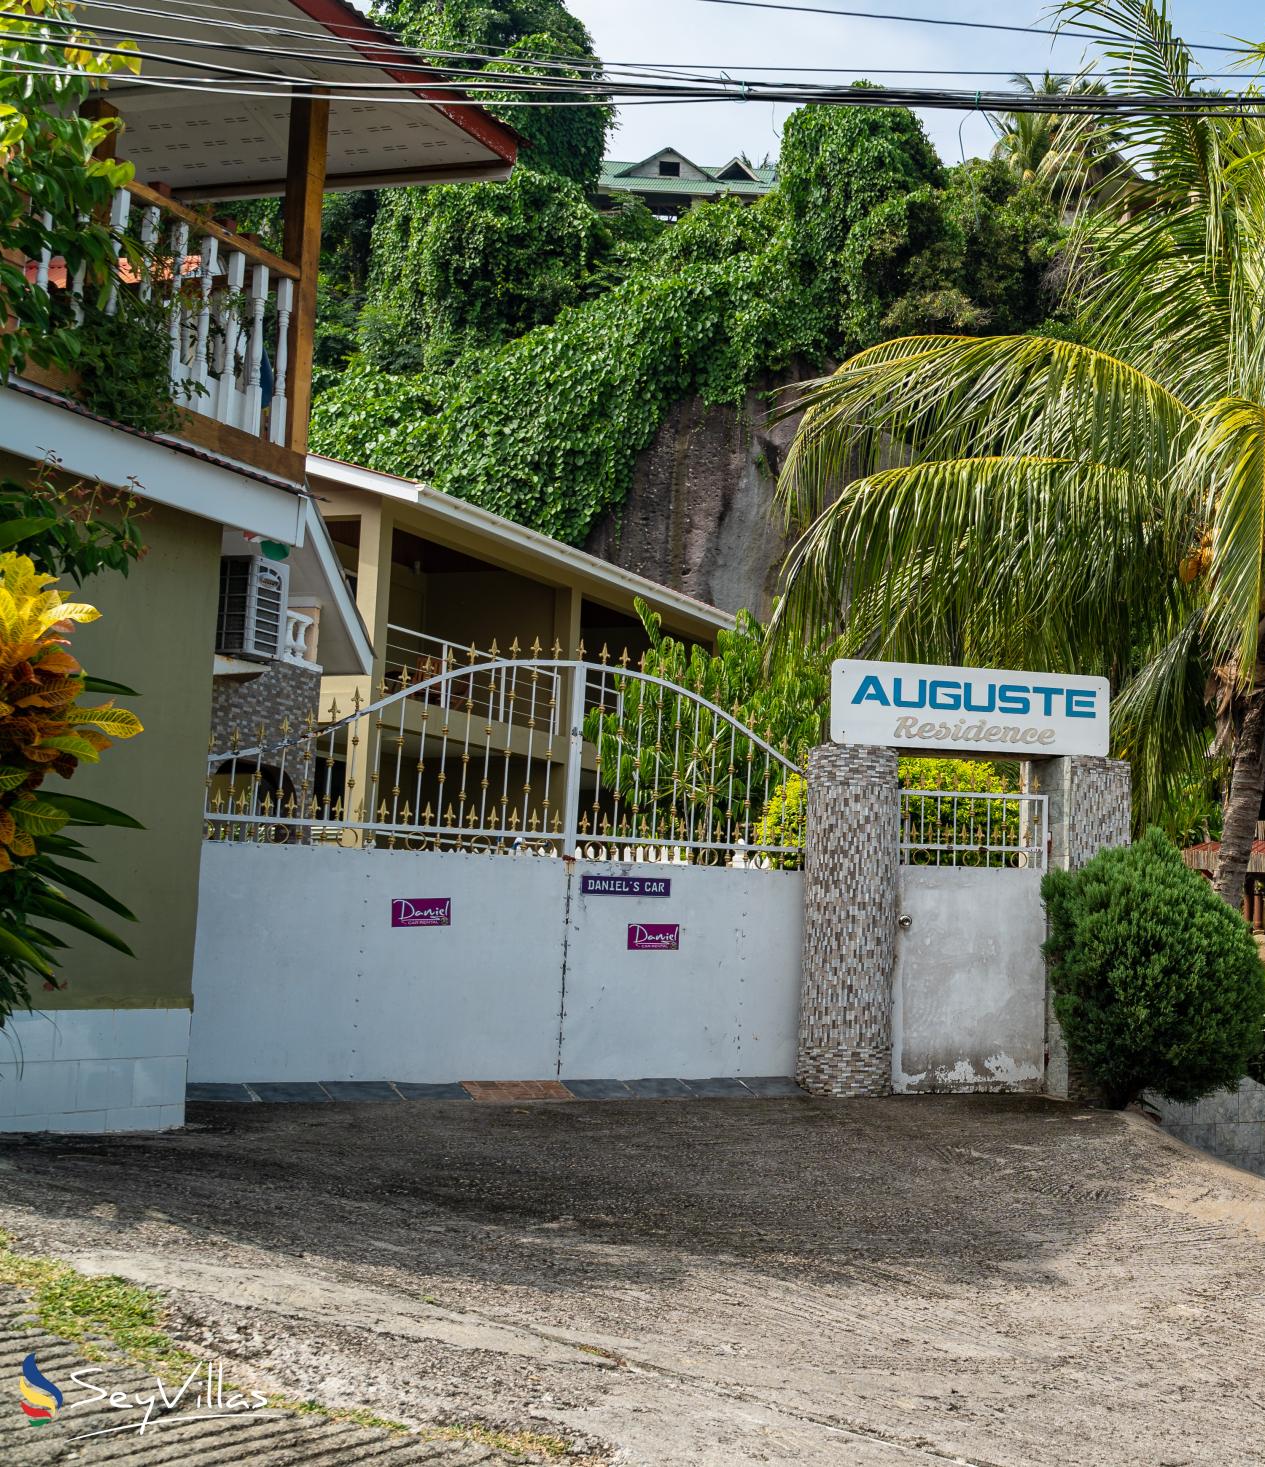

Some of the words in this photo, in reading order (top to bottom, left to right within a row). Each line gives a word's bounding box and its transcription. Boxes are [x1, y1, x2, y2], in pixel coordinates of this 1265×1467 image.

[851, 675, 1097, 719] AUGUSTE
[893, 715, 1056, 746] Residence
[587, 879, 640, 892] DANIEL'S
[644, 881, 665, 893] CAR
[392, 899, 450, 920] Daniel
[628, 924, 679, 943] Daniel
